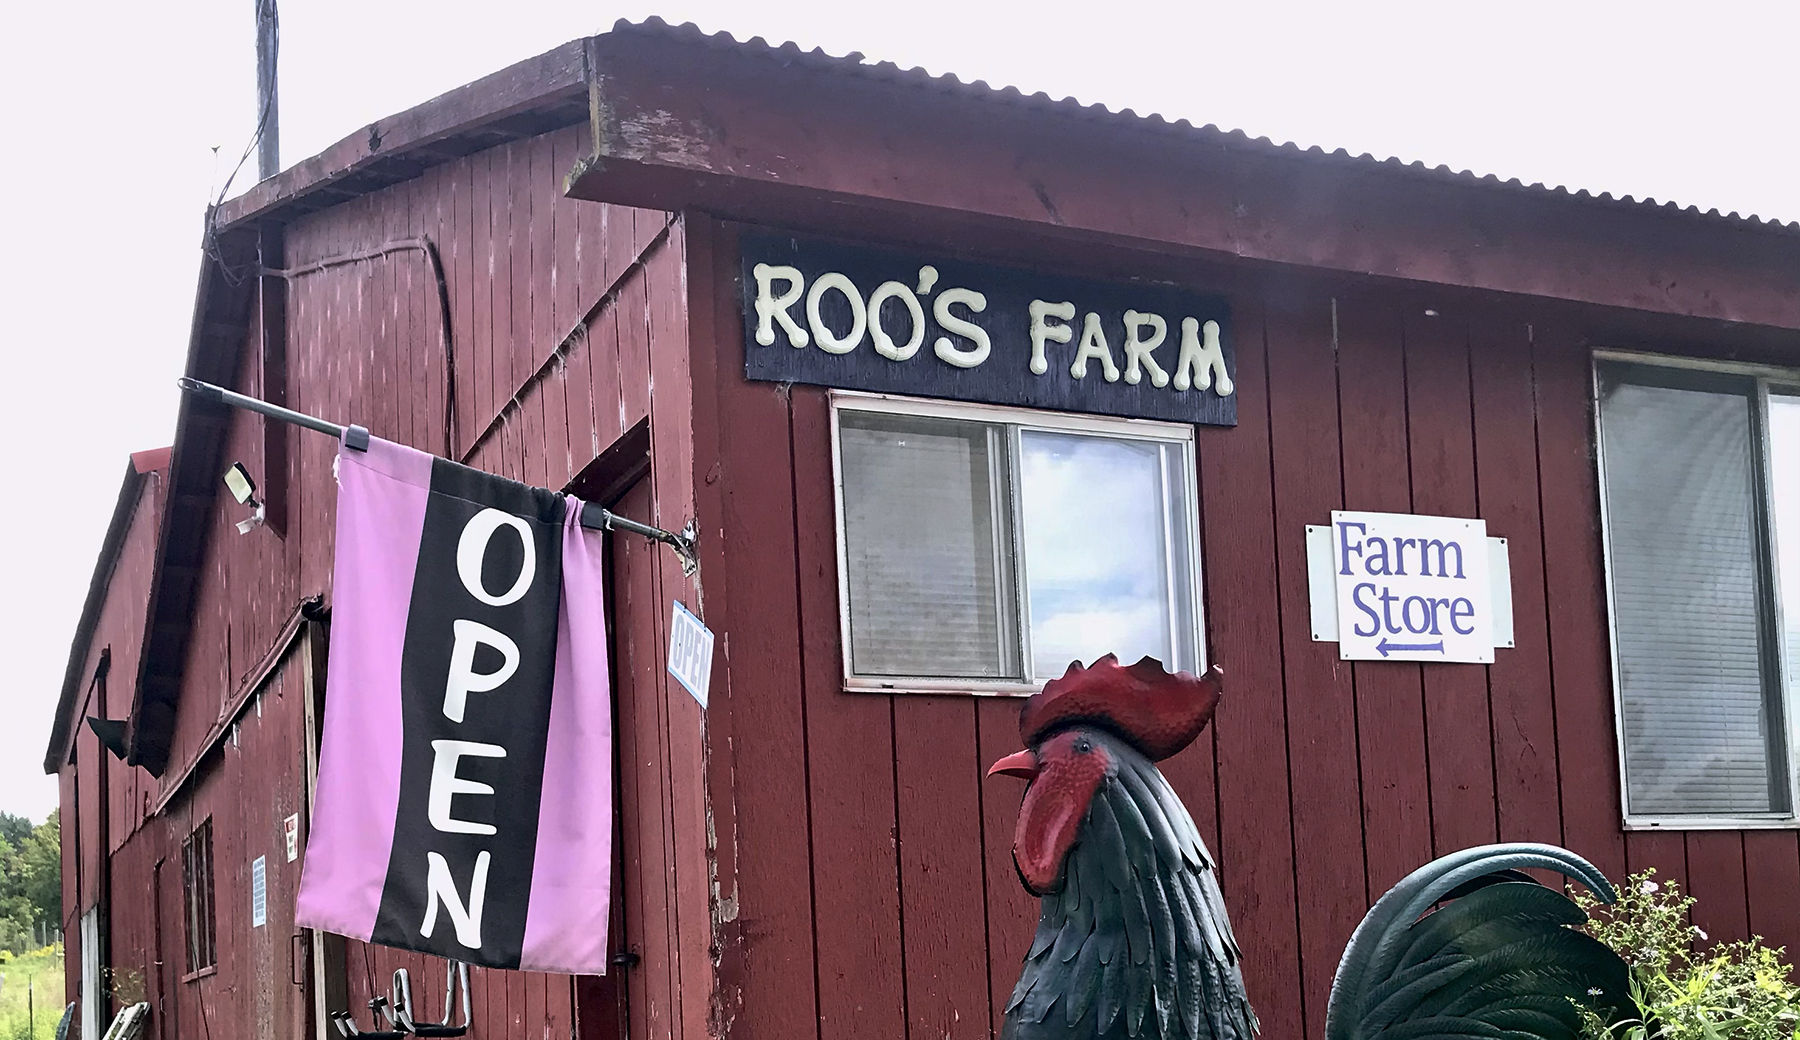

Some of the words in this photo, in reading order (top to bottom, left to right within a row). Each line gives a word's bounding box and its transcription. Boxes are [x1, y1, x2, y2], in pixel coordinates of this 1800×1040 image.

[753, 263, 991, 368] ROO'S
[1029, 299, 1234, 397] FARM
[1336, 521, 1467, 579] Farm
[1352, 582, 1475, 637] Store
[672, 613, 711, 696] OPEN
[420, 507, 536, 949] OPEN
